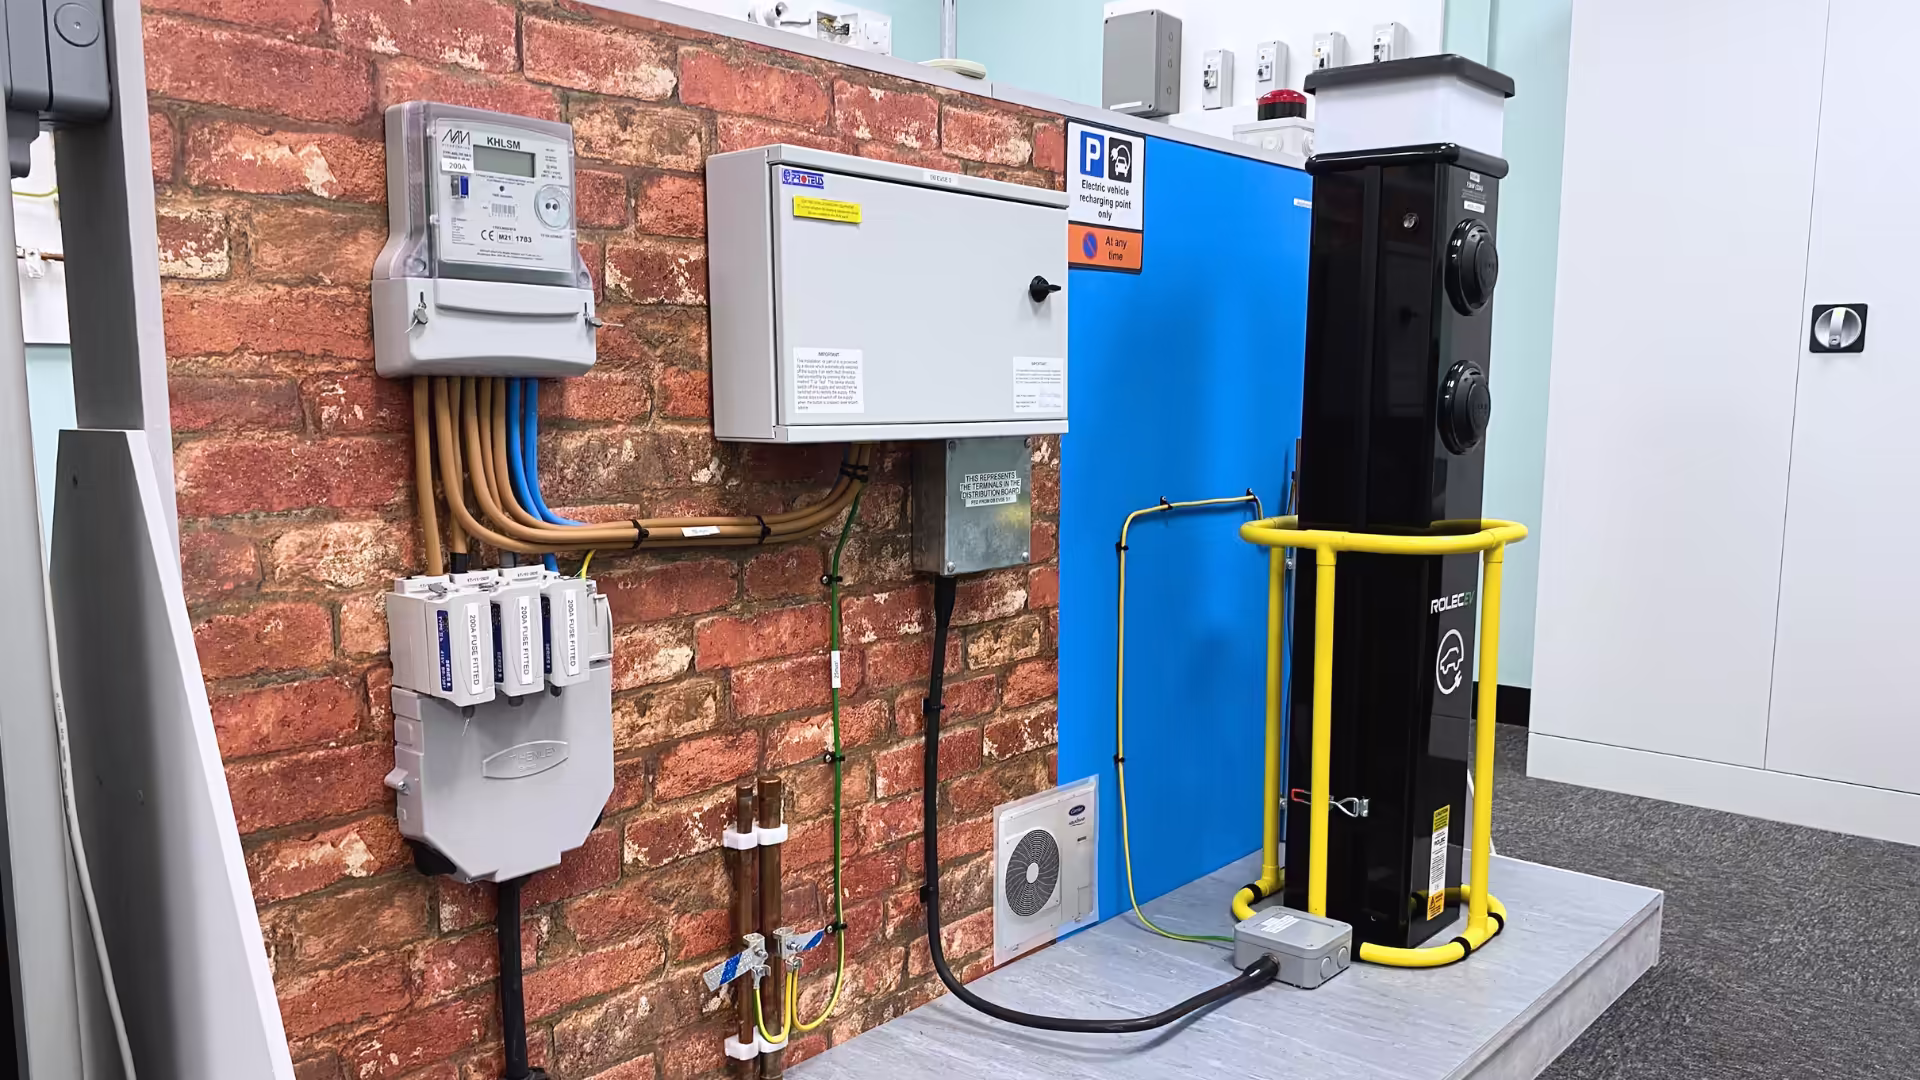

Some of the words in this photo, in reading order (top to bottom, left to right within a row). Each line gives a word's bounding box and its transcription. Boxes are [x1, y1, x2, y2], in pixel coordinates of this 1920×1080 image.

[486, 136, 520, 150] KHLSM
[1086, 136, 1100, 172] P
[449, 162, 467, 170] 200A
[1082, 180, 1106, 193] Electric
[1106, 184, 1130, 196] vehicle
[1080, 194, 1114, 210] recharging
[1114, 200, 1132, 210] point
[1098, 210, 1112, 221] only
[1105, 236, 1114, 246] At
[1114, 238, 1128, 250] any
[1108, 251, 1123, 261] time
[966, 474, 979, 482] THIS
[980, 472, 1015, 482] REPRESENTS
[972, 481, 1002, 490] TERMINALS
[962, 490, 1000, 499] DISTRIBUTION
[1001, 487, 1019, 495] BOARD
[472, 656, 480, 686] FITTED
